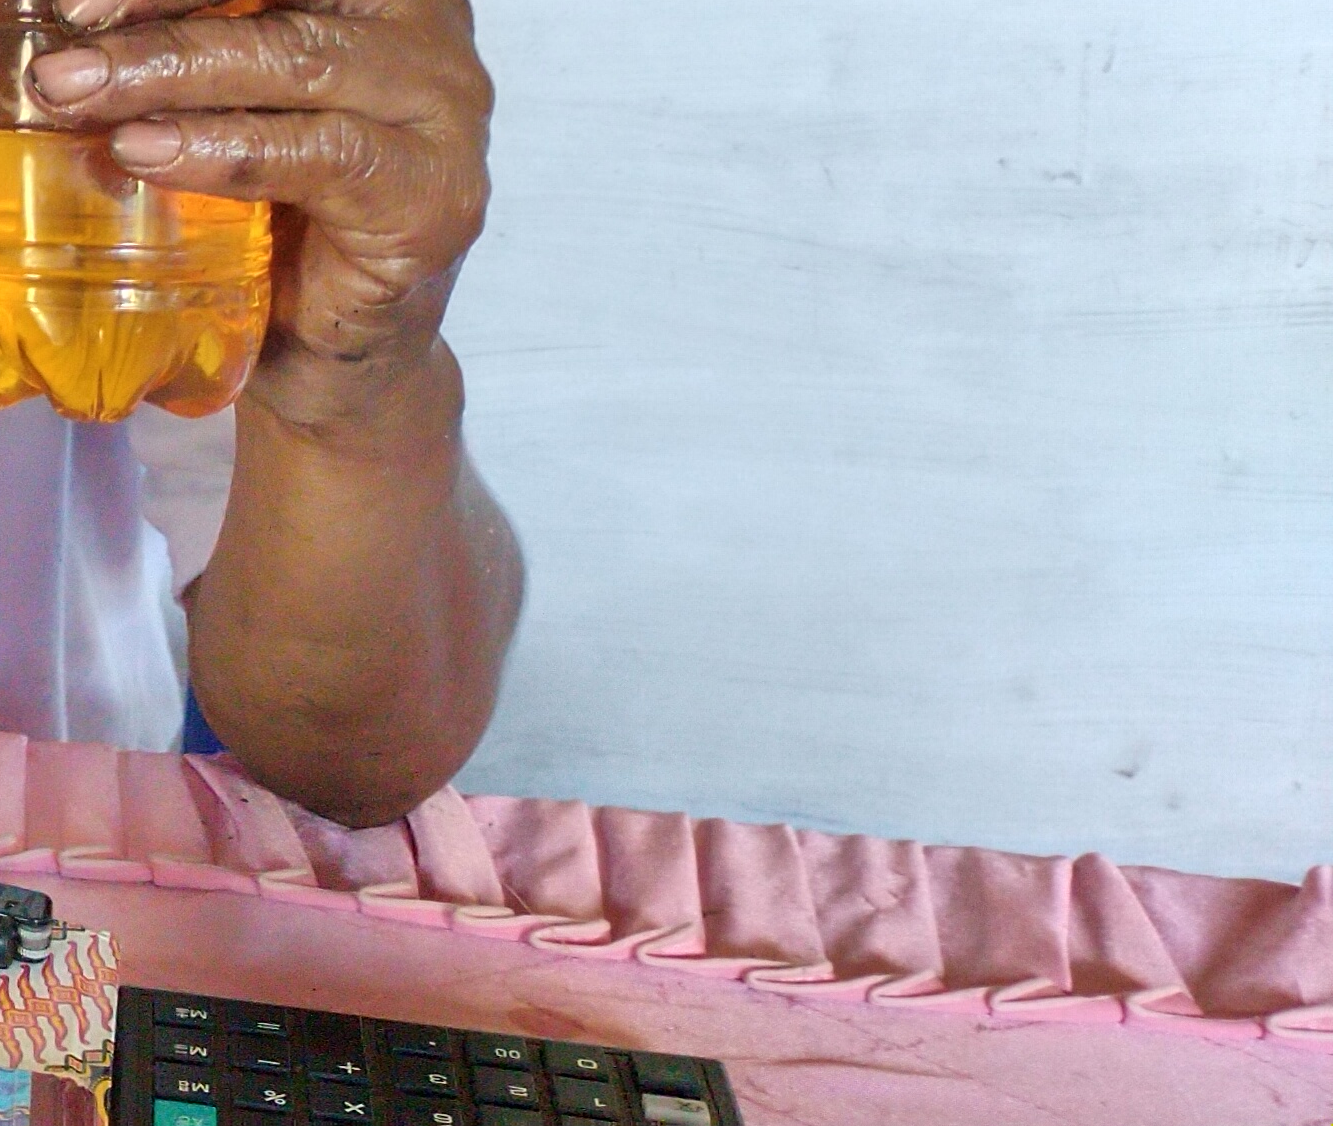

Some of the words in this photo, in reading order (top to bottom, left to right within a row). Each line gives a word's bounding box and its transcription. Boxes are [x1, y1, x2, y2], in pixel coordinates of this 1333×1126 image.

[495, 1047, 520, 1060] 00
[577, 1058, 597, 1070] 0
[429, 1073, 447, 1085] 3
[509, 1085, 528, 1098] 2
